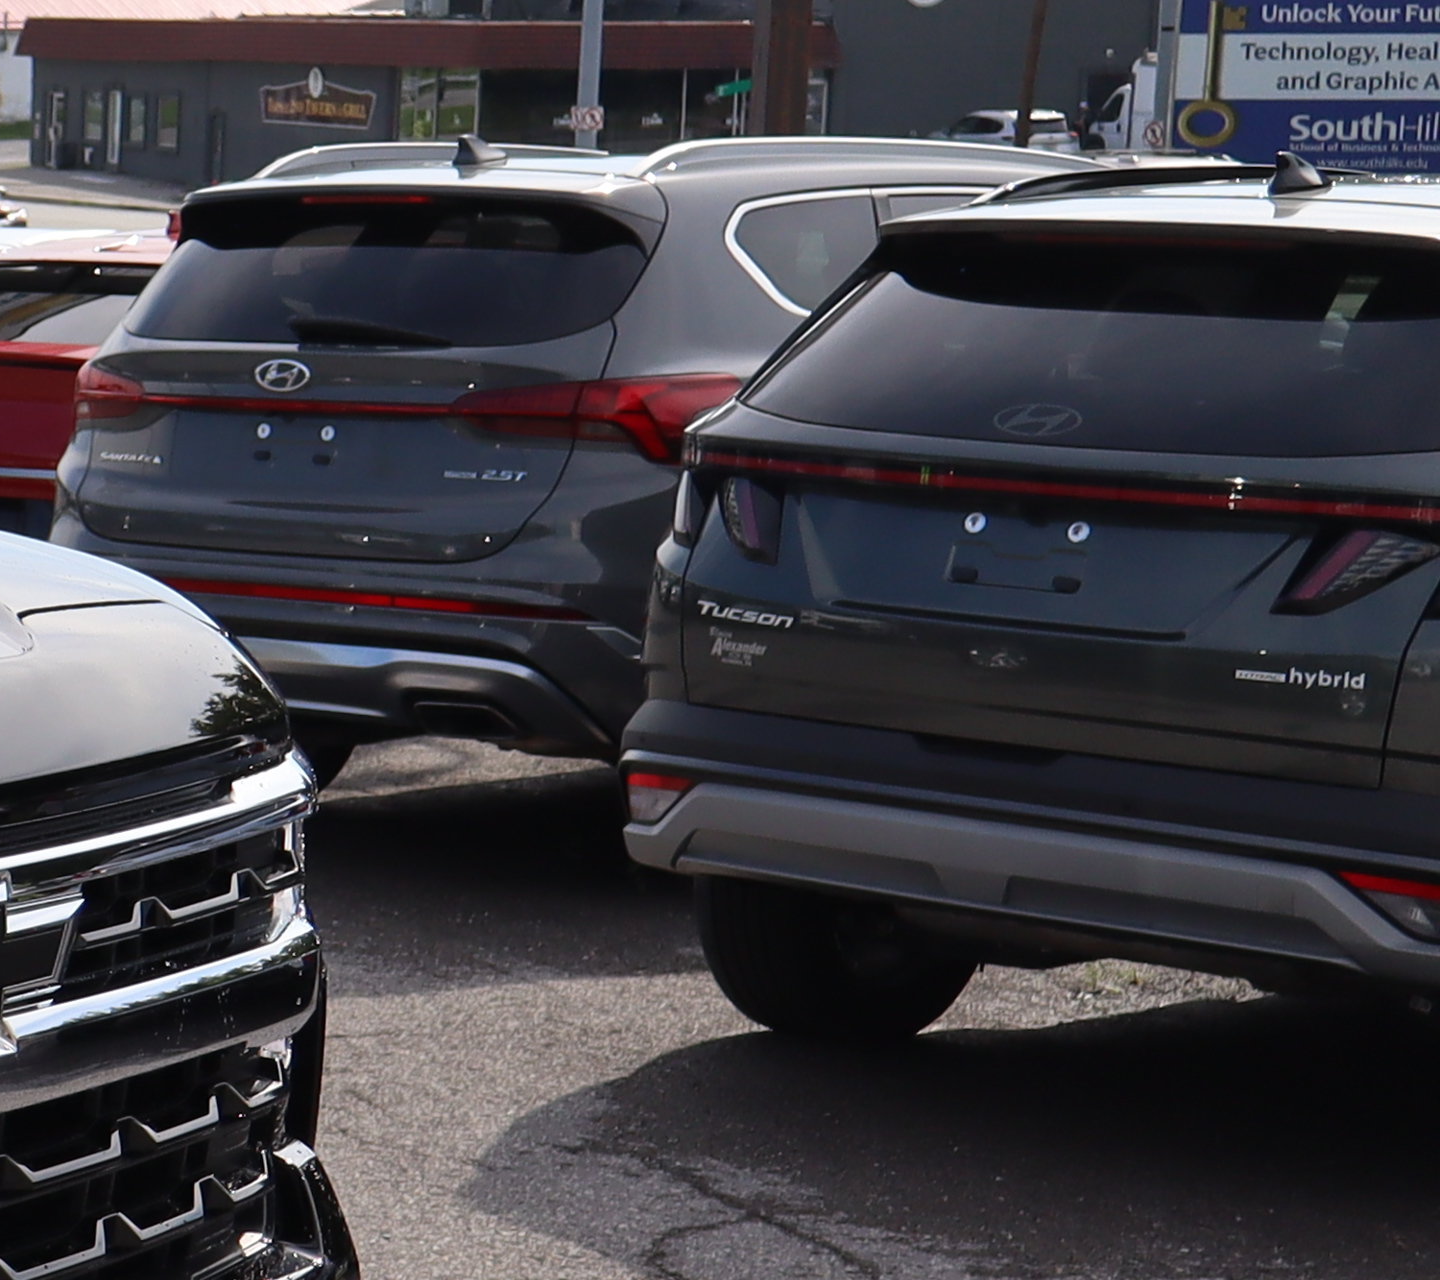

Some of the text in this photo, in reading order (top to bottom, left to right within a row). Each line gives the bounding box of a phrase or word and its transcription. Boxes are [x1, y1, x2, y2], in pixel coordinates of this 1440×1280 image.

[1261, 2, 1342, 24] Unlock
[1347, 2, 1401, 24] Your
[1240, 41, 1439, 66] Technology, Heal
[1275, 72, 1321, 91] and
[1325, 71, 1418, 95] Graphic
[1329, 141, 1340, 153] of
[1341, 141, 1388, 153] Business
[1288, 666, 1366, 690] hybrid
